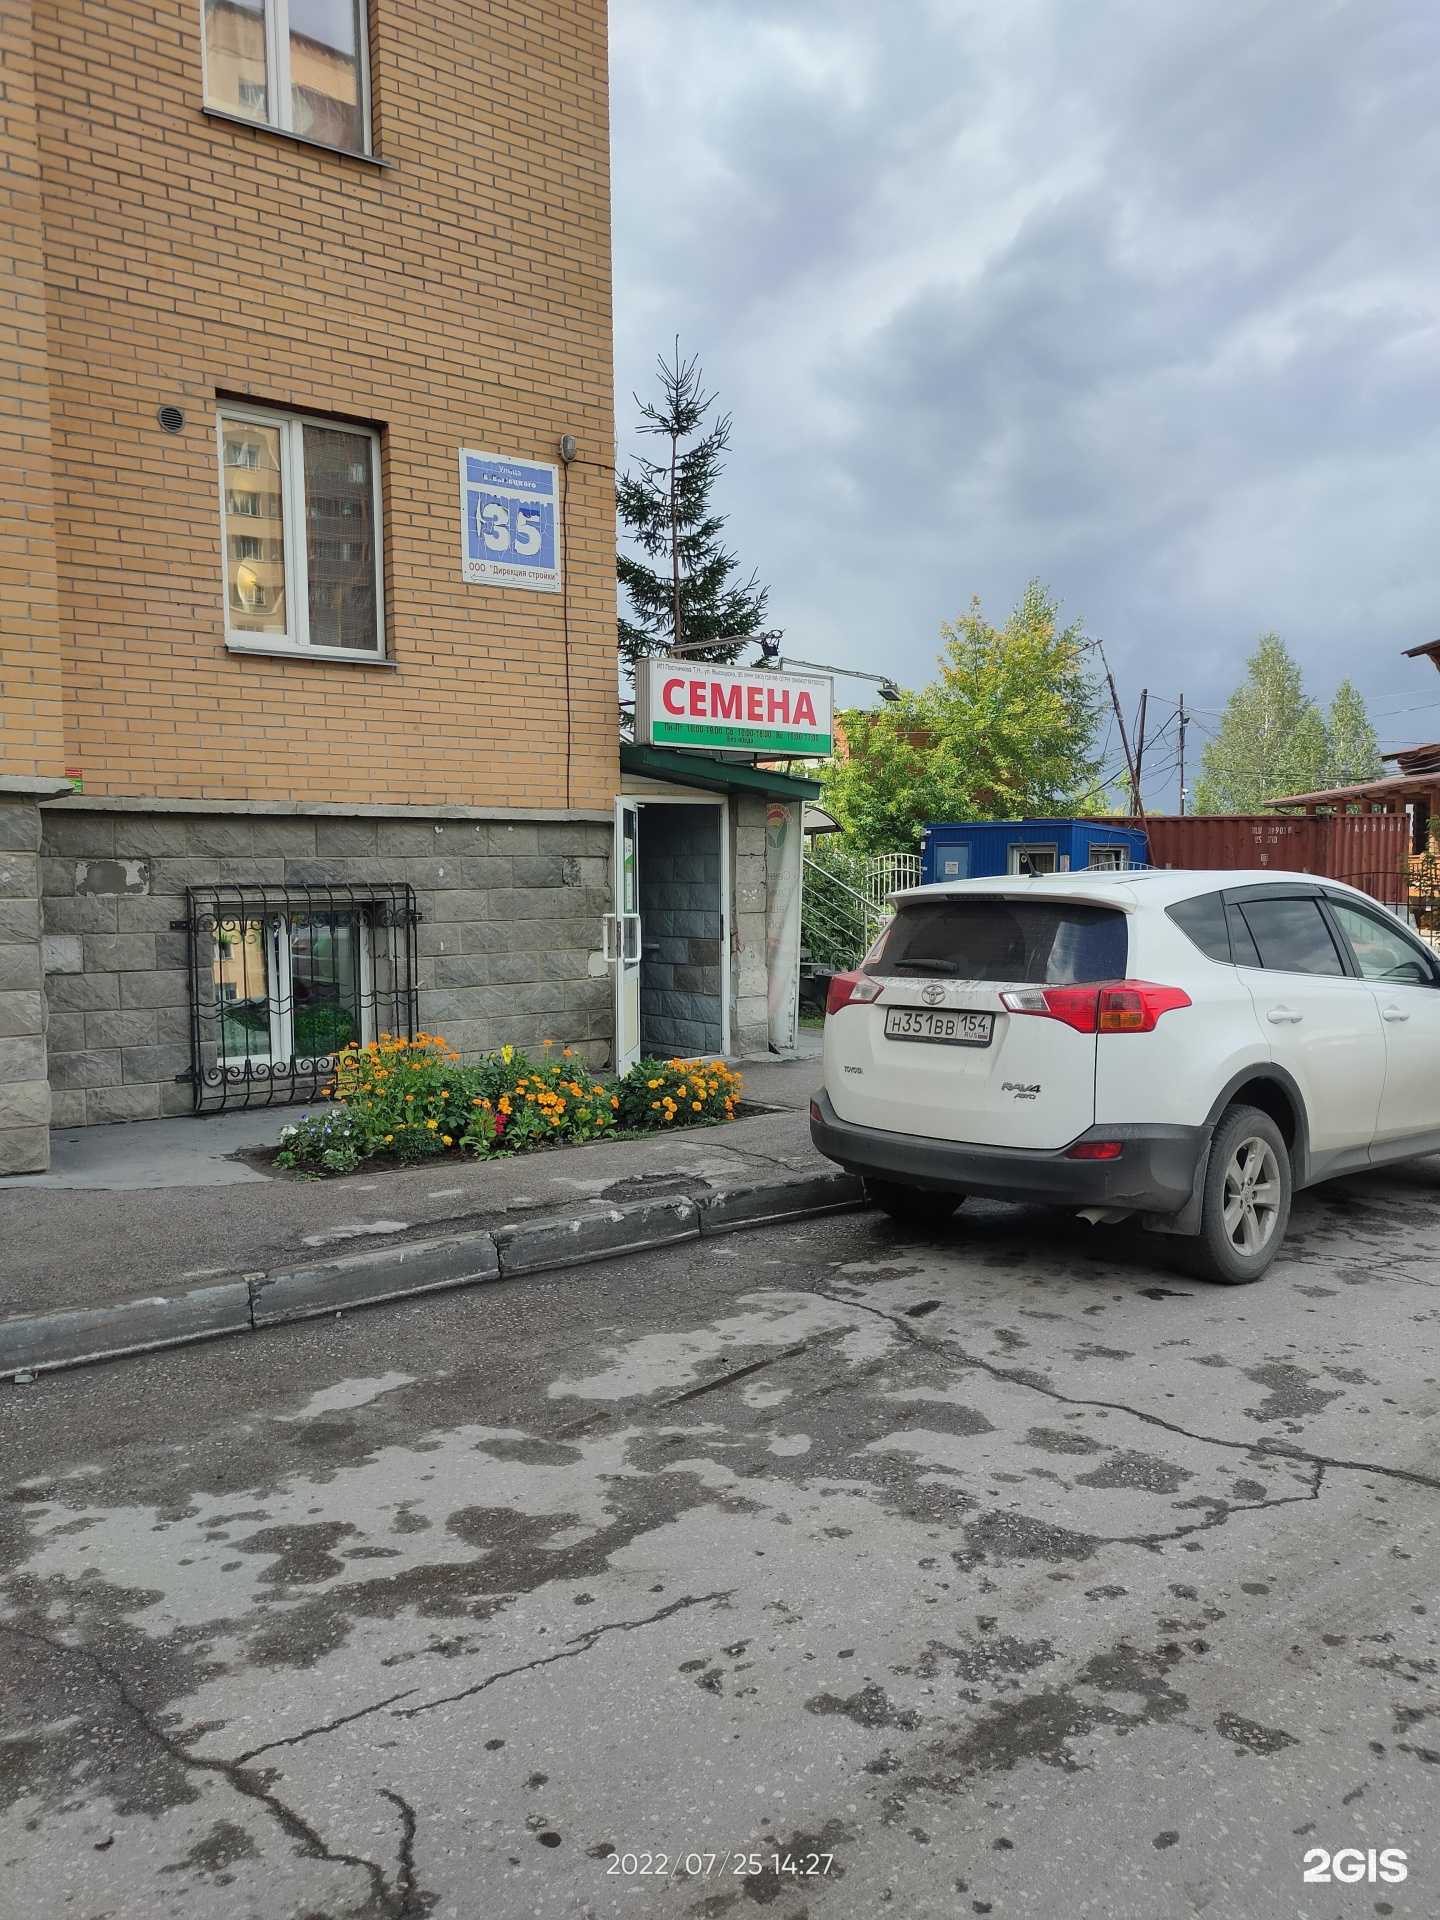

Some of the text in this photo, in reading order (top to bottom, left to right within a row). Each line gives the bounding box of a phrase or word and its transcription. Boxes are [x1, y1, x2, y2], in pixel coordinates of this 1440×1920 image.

[482, 503, 542, 556] 35
[469, 562, 486, 572] ООО
[662, 678, 817, 726] СЕМЕНА
[961, 1015, 986, 1032] 154
[1001, 1081, 1041, 1093] RAV4
